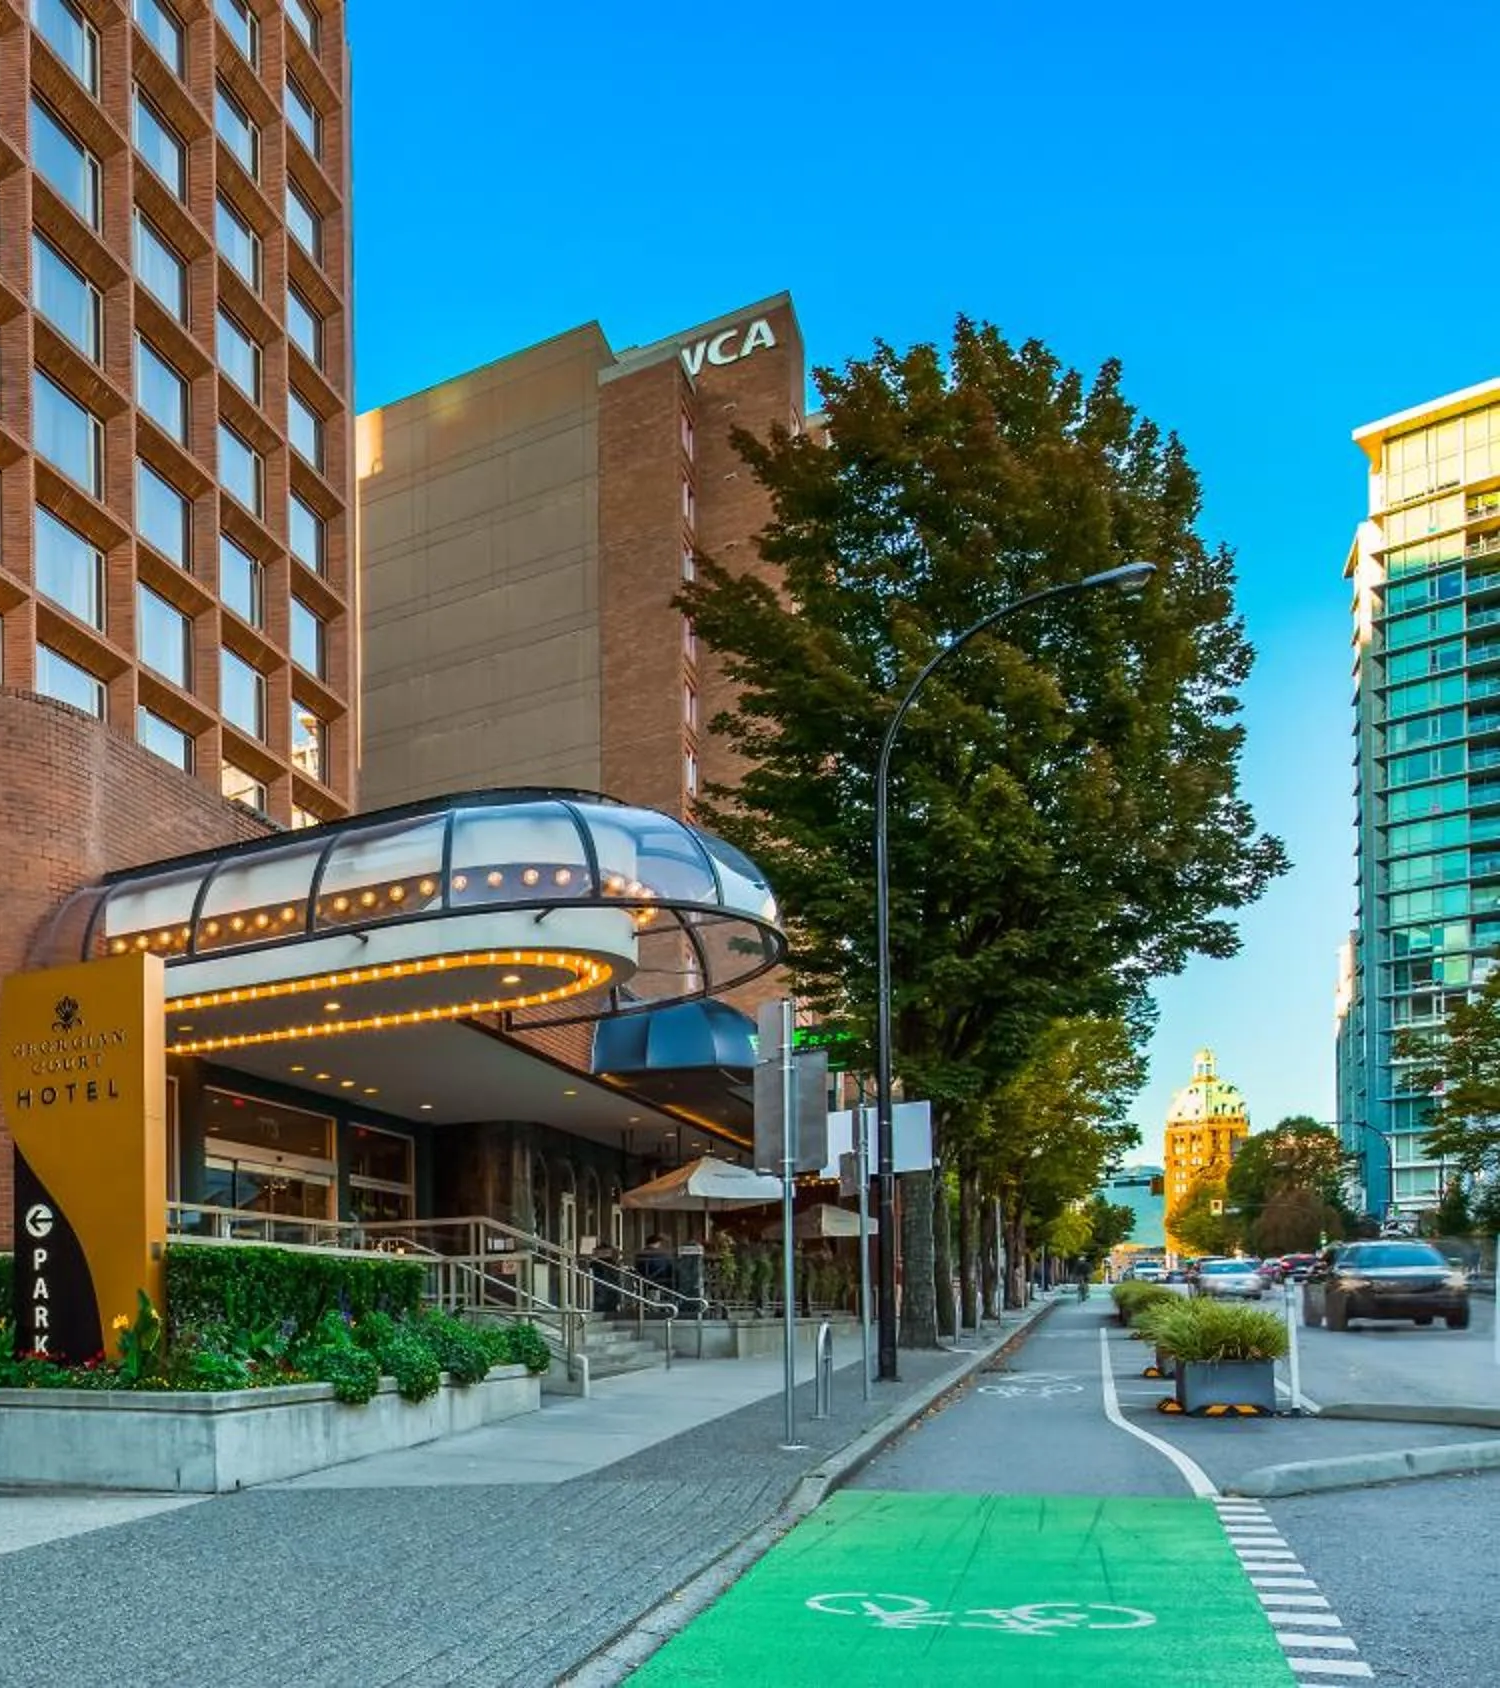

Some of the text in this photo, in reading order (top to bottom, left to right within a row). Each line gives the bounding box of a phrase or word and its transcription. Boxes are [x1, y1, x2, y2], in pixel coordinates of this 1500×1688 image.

[11, 1029, 128, 1059] GEORGIAN
[31, 1053, 103, 1076] COURT
[16, 1079, 120, 1109] HOTEL
[32, 1247, 50, 1357] PARK
